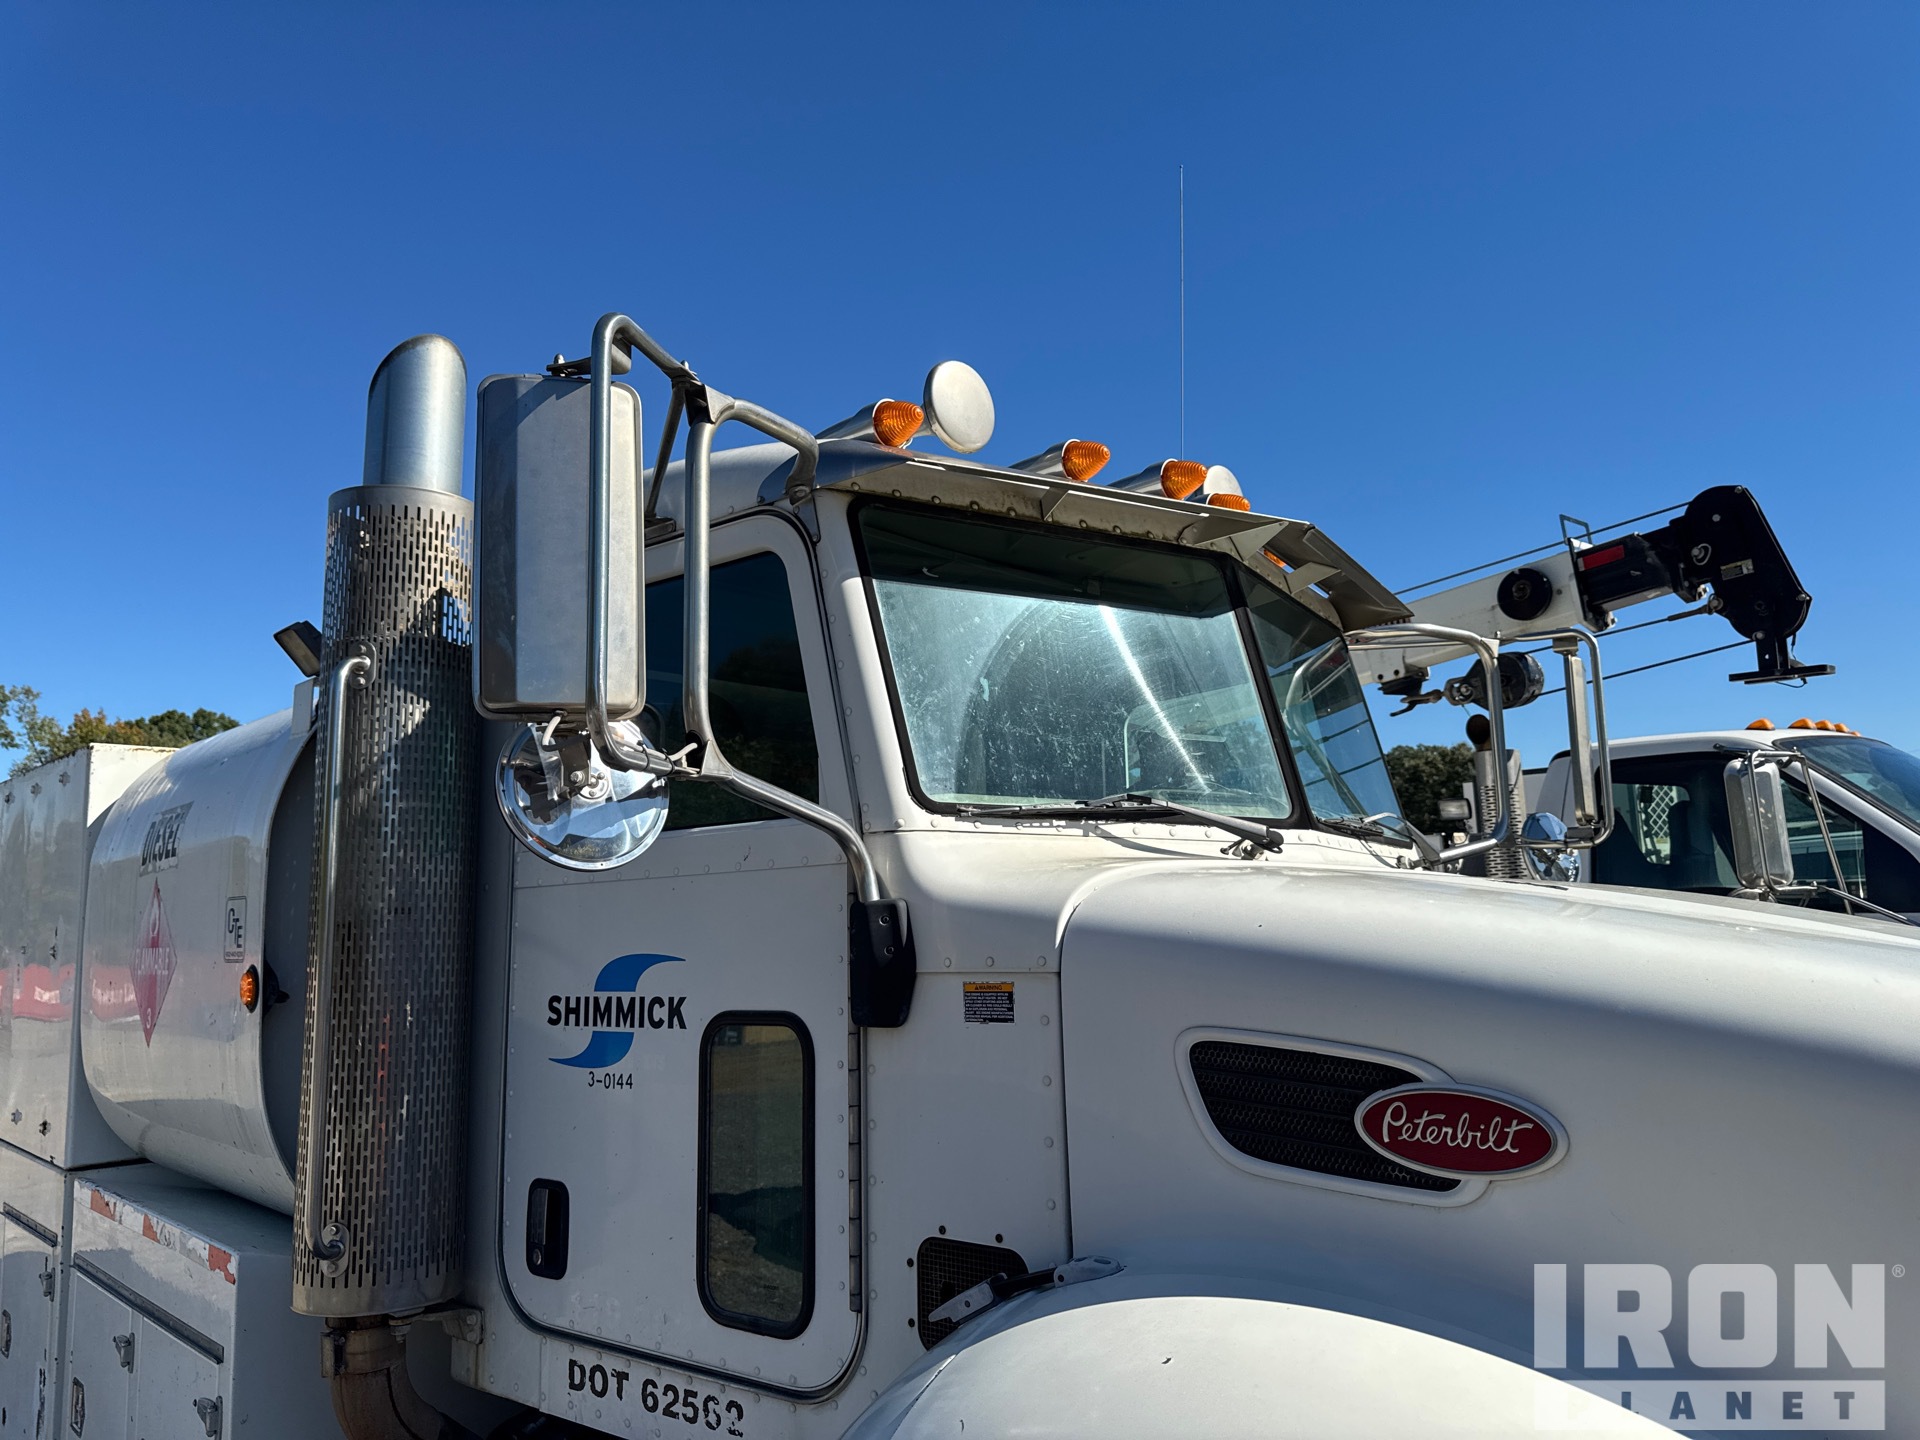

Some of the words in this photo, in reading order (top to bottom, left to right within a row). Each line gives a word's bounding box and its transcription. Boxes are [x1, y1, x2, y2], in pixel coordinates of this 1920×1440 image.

[142, 813, 185, 866] DIESEL
[228, 908, 243, 948] CTE
[146, 1008, 152, 1029] 3
[547, 995, 687, 1029] SHIMMICK
[588, 1071, 633, 1089] 3-0144
[1382, 1101, 1534, 1153] Peterbilt
[568, 1359, 629, 1401] DOT
